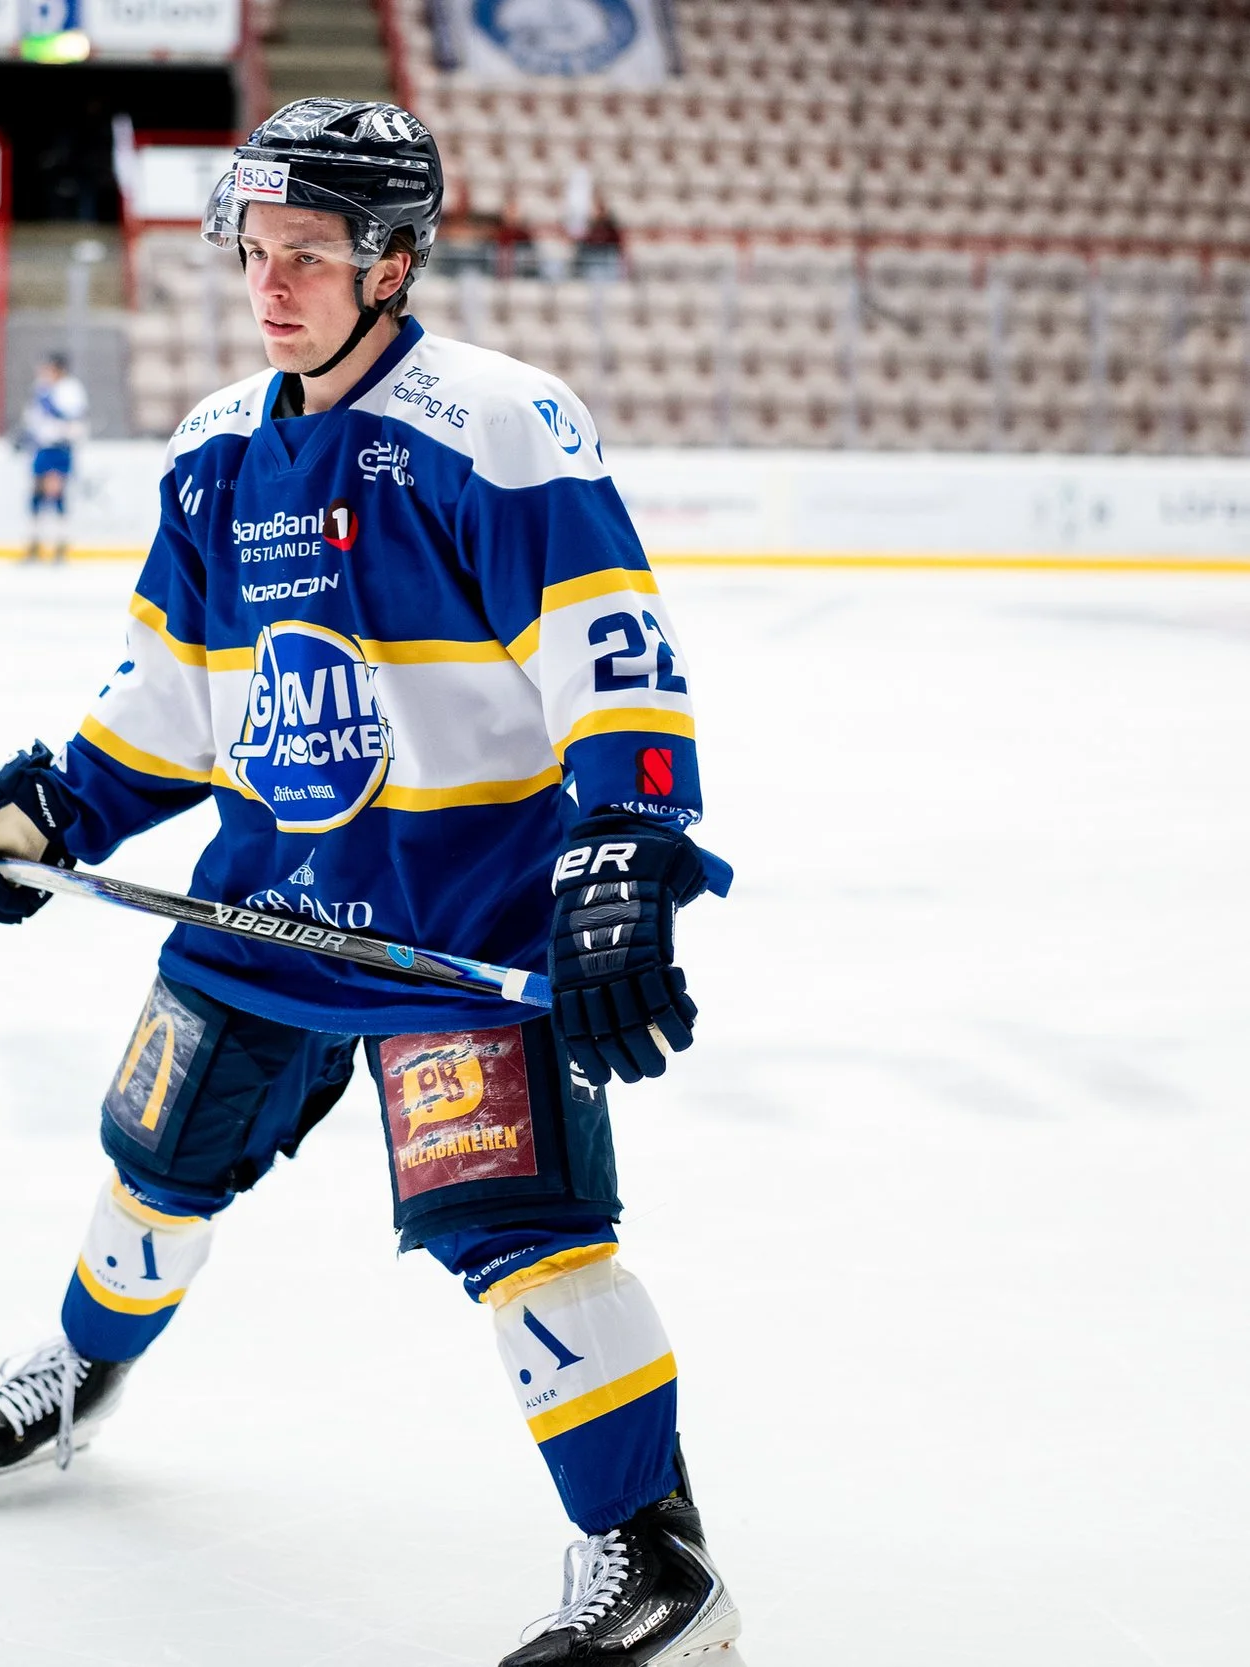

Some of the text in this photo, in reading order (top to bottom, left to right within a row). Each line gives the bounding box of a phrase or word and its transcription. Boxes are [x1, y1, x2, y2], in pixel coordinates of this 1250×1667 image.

[440, 403, 470, 429] AS
[241, 541, 322, 563] ØSTLANDE
[273, 784, 336, 802] Stiftet 1990
[245, 889, 373, 929] GRAND
[231, 913, 348, 952] BAUER
[525, 1388, 558, 1410] ALVER
[621, 1604, 670, 1650] BAUER
